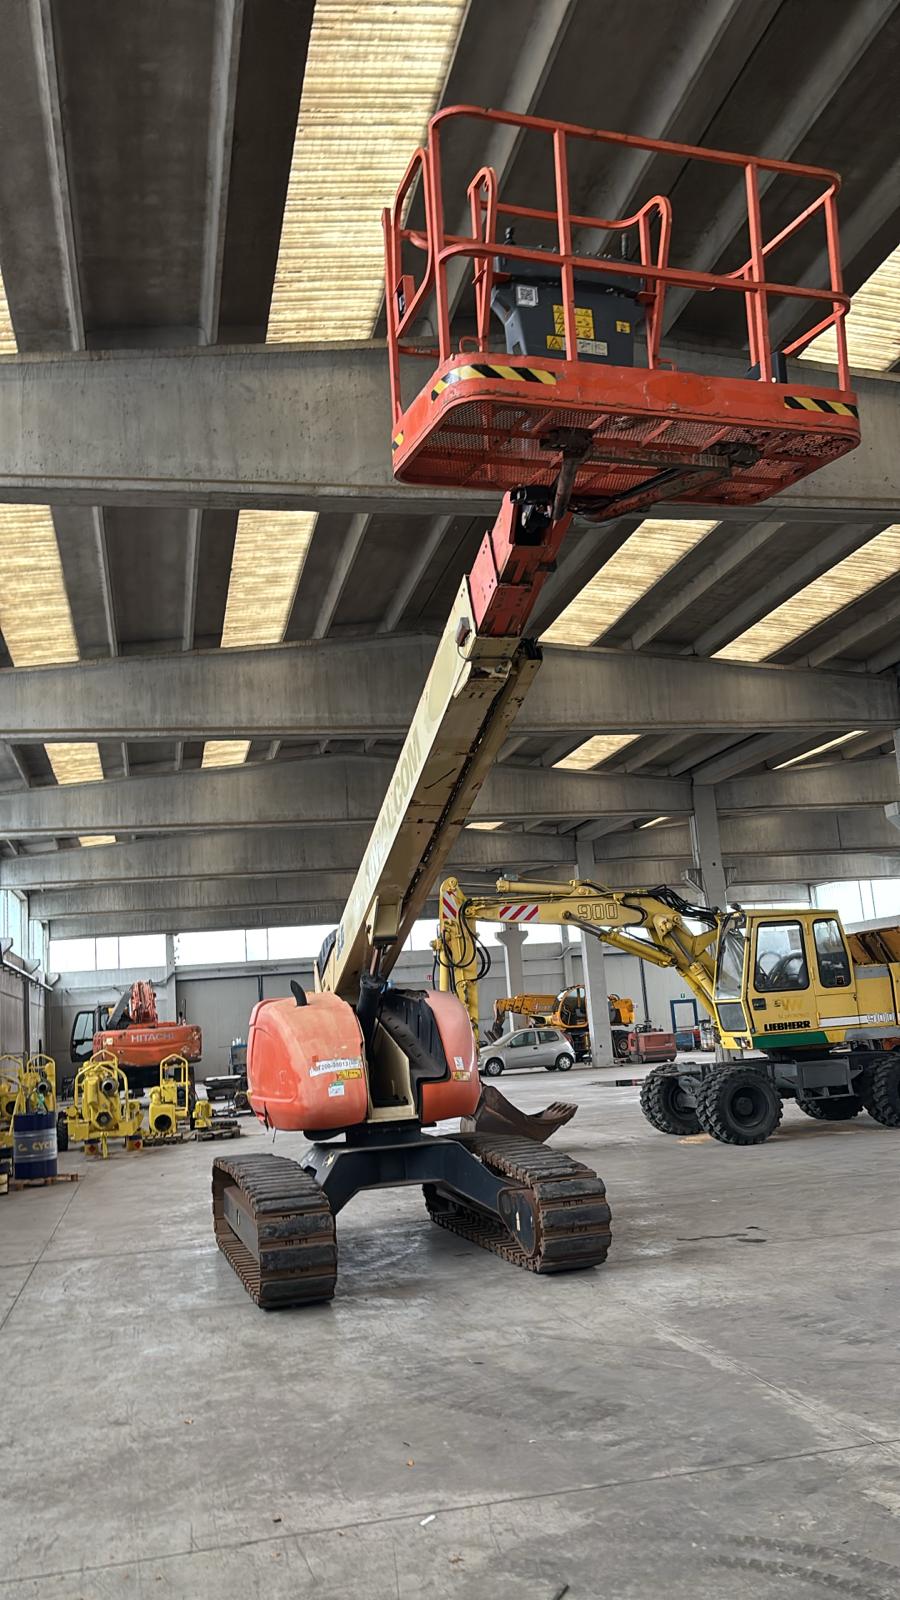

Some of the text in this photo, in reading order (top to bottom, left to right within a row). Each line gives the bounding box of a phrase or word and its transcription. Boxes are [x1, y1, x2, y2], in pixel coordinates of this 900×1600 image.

[577, 903, 618, 920] 900
[764, 1020, 811, 1032] LIEBHERR
[131, 1032, 176, 1043] HITACHI
